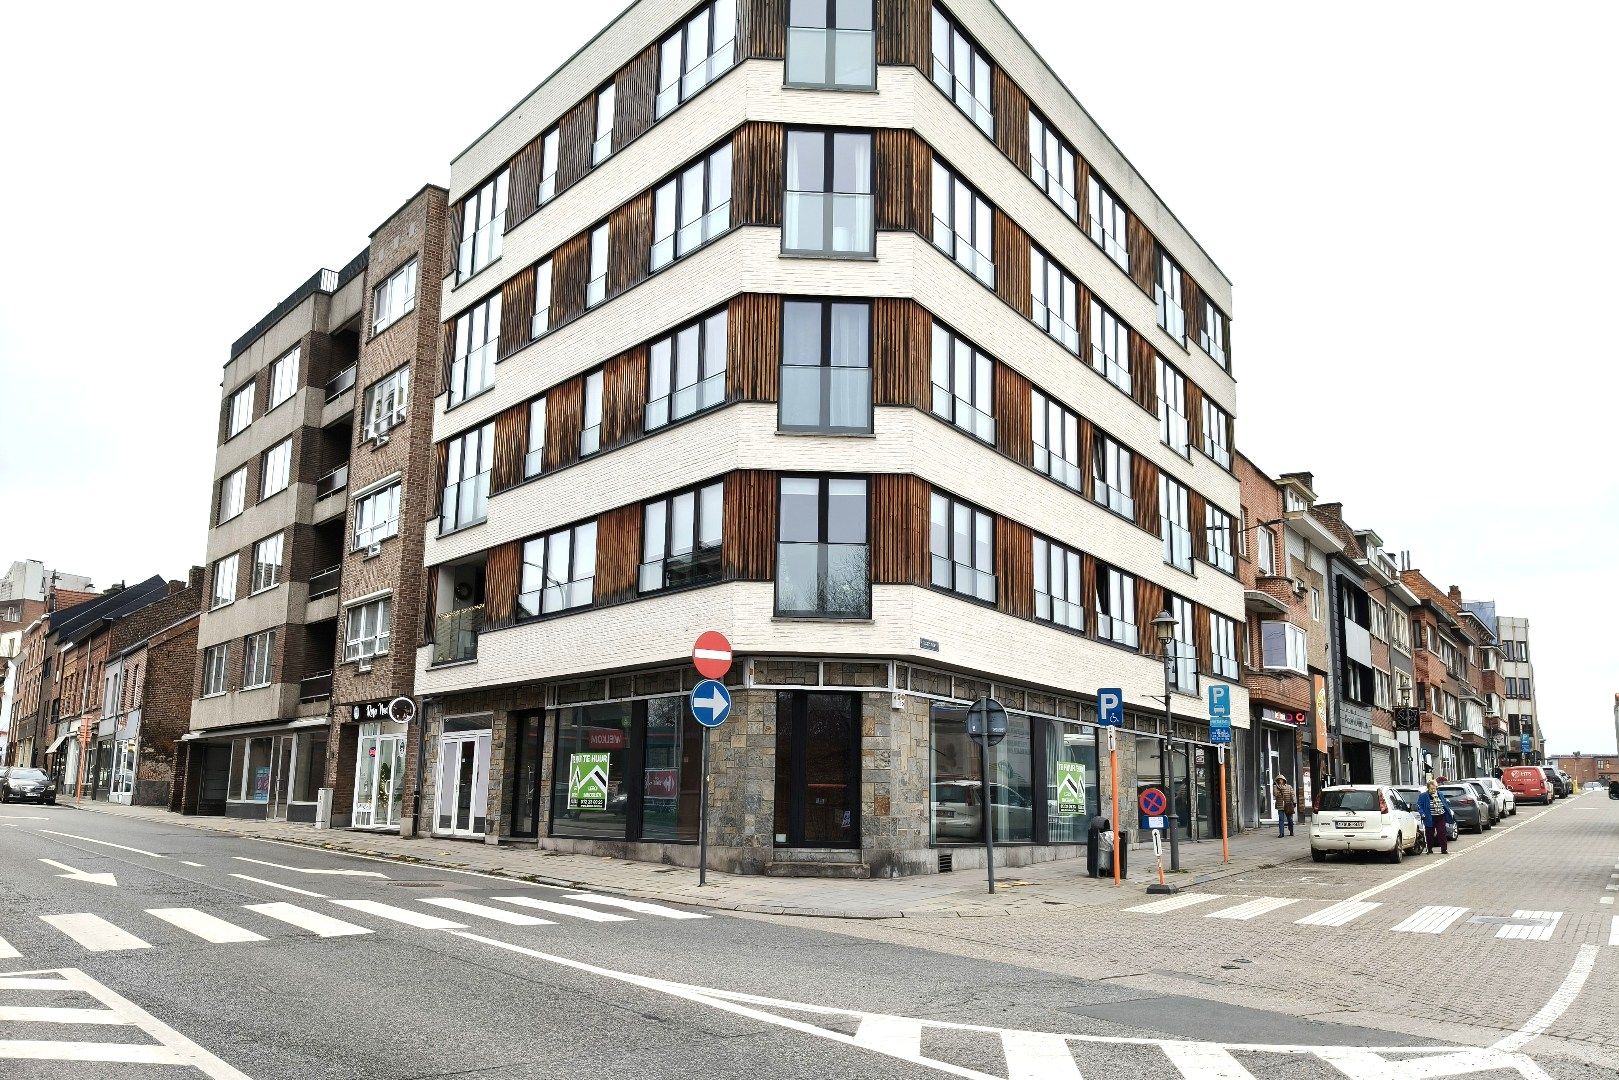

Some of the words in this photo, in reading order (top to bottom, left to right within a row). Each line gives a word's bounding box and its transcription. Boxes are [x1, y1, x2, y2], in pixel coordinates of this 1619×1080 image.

[1213, 687, 1225, 704] P
[1100, 693, 1119, 720] P
[583, 754, 591, 763] TE
[592, 754, 608, 763] HUUR
